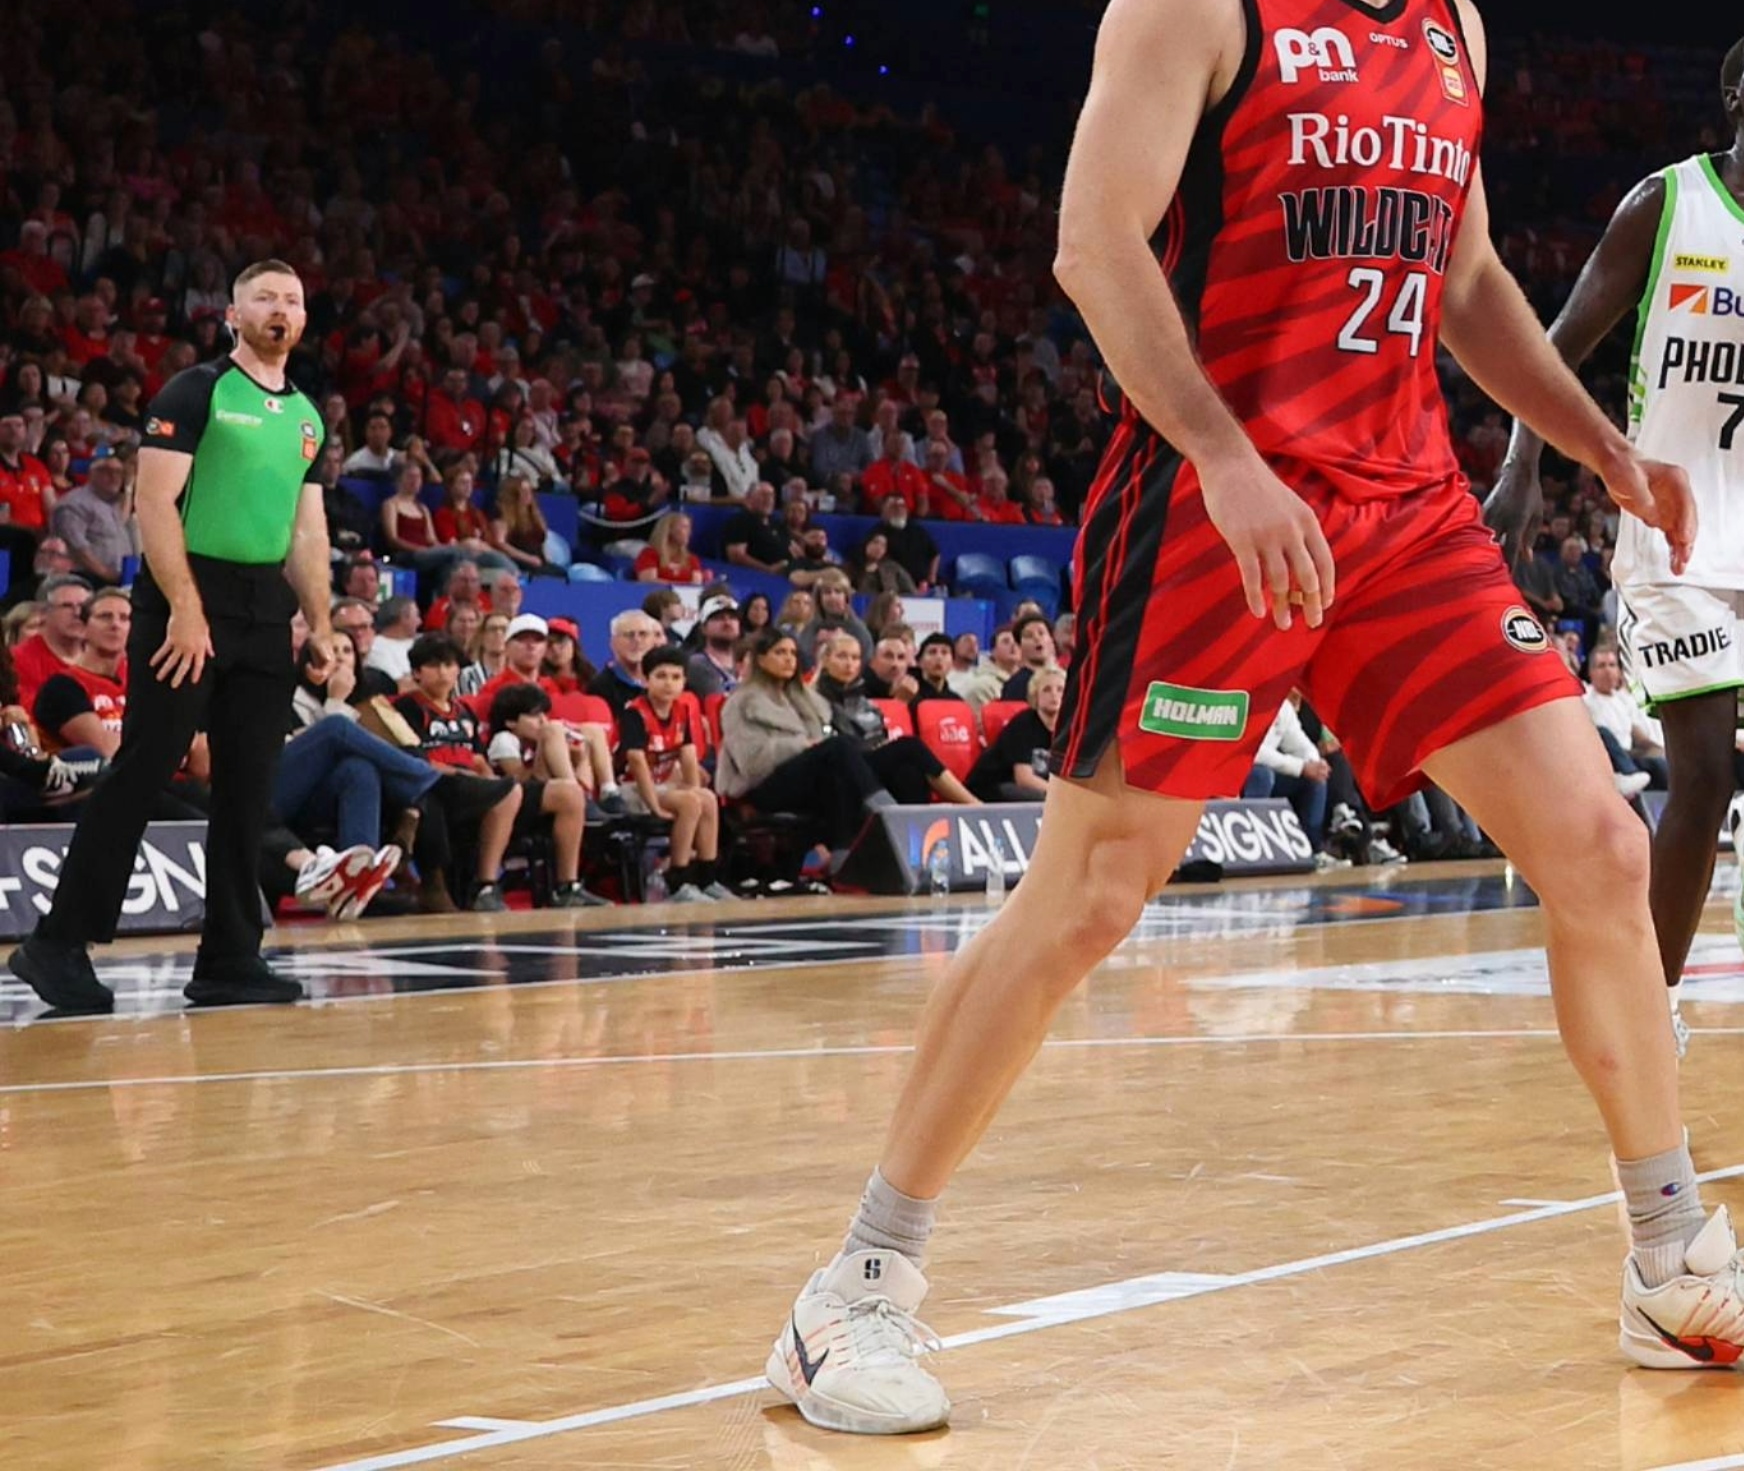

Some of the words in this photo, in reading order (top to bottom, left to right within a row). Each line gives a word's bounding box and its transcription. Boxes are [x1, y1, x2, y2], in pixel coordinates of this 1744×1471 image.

[1369, 31, 1409, 49] OPTUS
[1318, 68, 1359, 83] bank
[1337, 266, 1428, 358] 24
[1638, 626, 1731, 669] TRADIE
[1152, 697, 1239, 727] HOLMAN
[958, 816, 1030, 876] ALL
[1188, 808, 1313, 863] SIGNS
